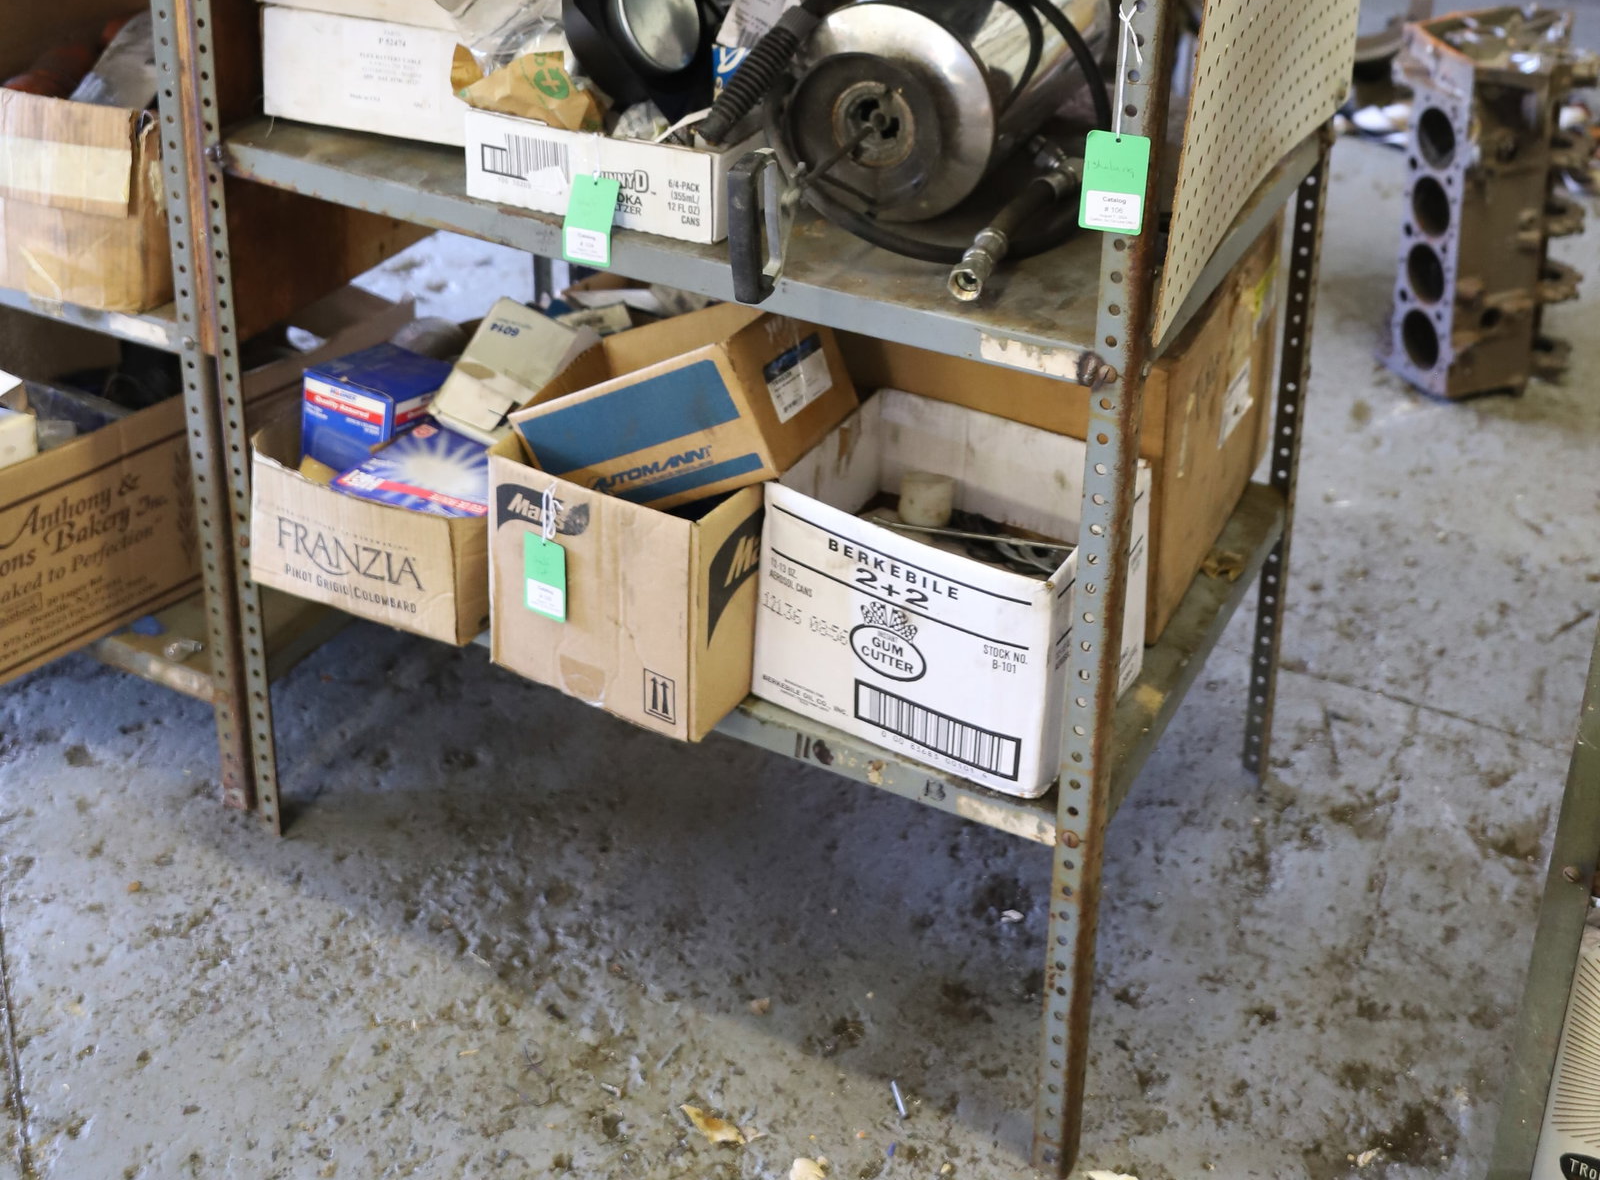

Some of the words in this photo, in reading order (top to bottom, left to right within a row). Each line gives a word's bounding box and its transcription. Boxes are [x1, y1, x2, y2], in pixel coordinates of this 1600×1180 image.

[667, 179, 701, 193] 6/4-PACK
[667, 202, 676, 212] 12
[677, 203, 686, 214] FL
[687, 204, 701, 217] OZ)
[1102, 196, 1127, 205] Catalog
[681, 215, 701, 227] CANS
[0, 487, 112, 550] Anthony
[0, 549, 37, 577] ons
[43, 507, 130, 556] Bakery
[277, 515, 426, 592] FRANZIA
[1, 572, 43, 604] aked
[50, 563, 66, 583] to
[71, 527, 154, 573] Perfection
[285, 563, 314, 584] PINOT
[828, 538, 960, 601] BERKEBILE
[795, 582, 813, 598] CANS
[855, 567, 930, 611] 2+2
[871, 637, 904, 657] GUM
[983, 644, 1010, 662] STOCK
[1013, 652, 1028, 665] NO.
[861, 645, 915, 675] CUTTER
[992, 661, 1017, 674] B-101
